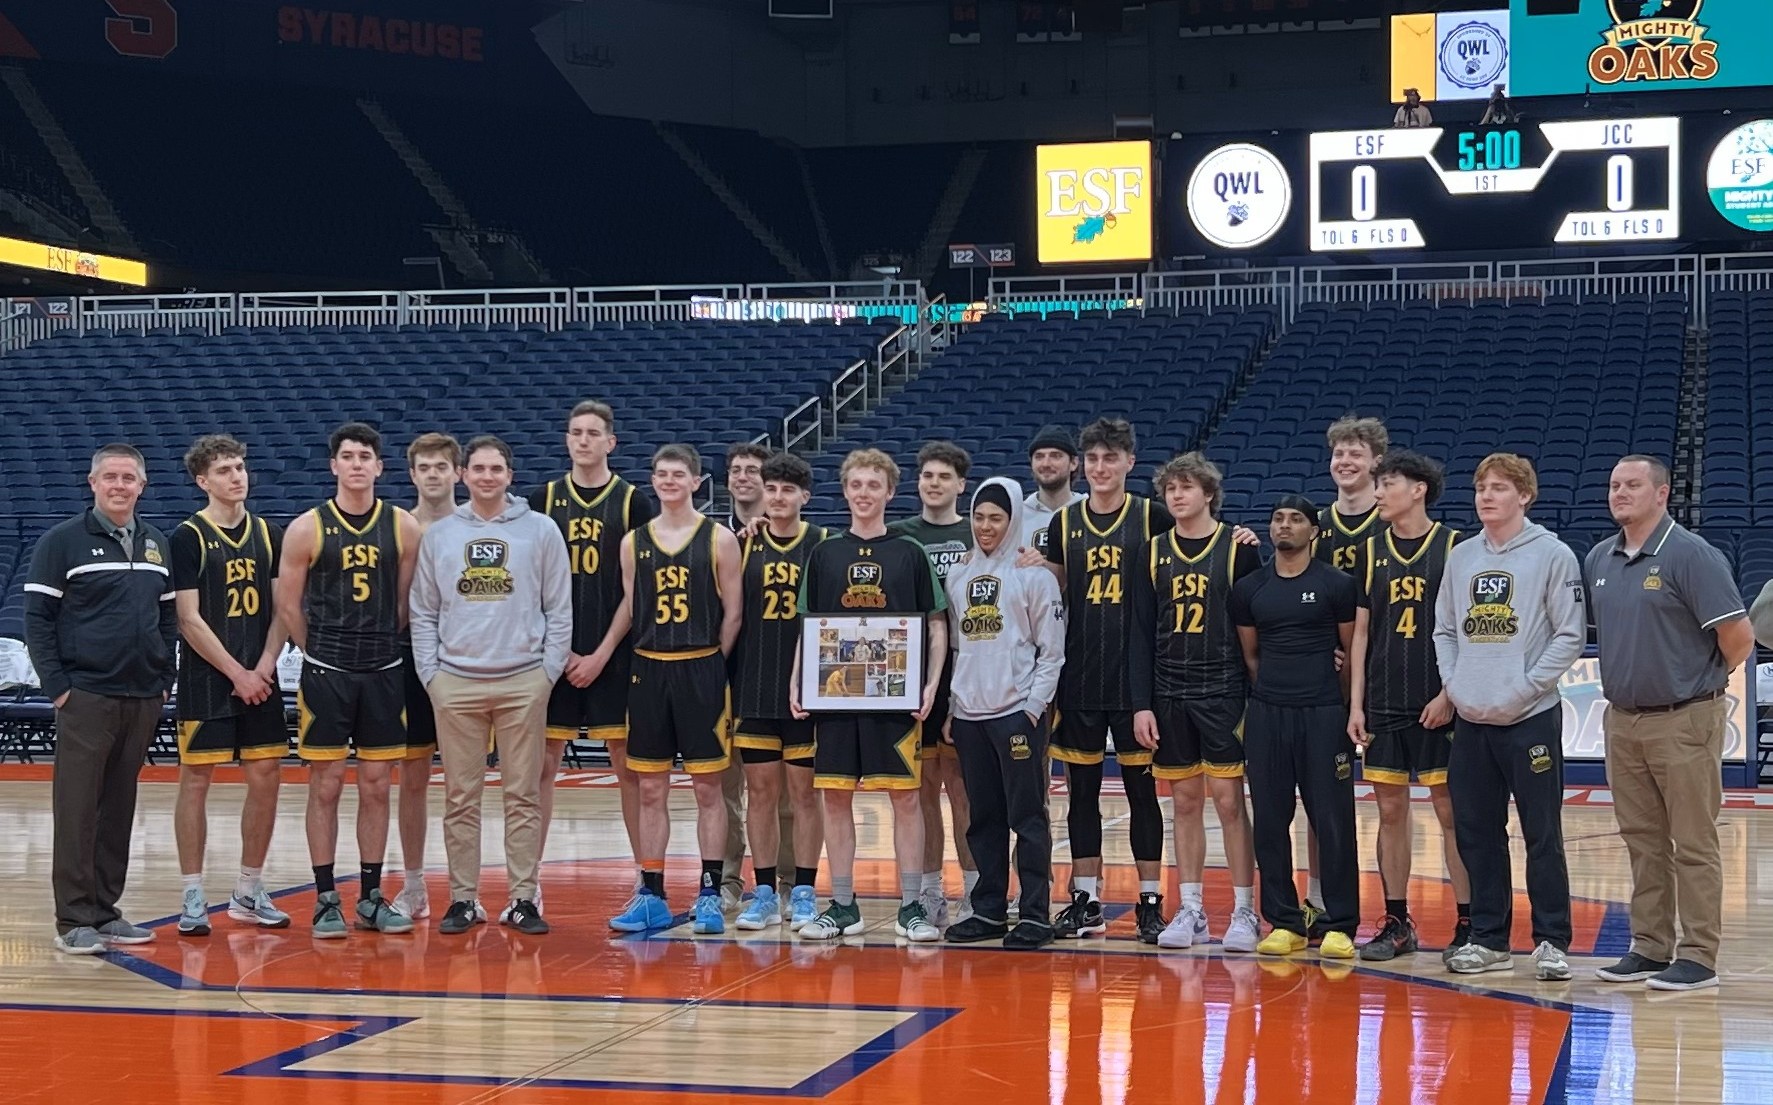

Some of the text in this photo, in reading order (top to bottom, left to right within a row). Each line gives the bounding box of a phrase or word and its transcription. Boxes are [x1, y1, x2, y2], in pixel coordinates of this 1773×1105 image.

[277, 4, 485, 63] SYRACUSE
[1619, 22, 1692, 39] MIGHTY
[1457, 39, 1490, 60] QWL
[1588, 40, 1719, 84] OAKS
[1355, 134, 1385, 155] ESF
[1601, 124, 1633, 145] JCC
[1458, 130, 1521, 171] 5:00
[1731, 158, 1766, 175] ESF
[1045, 166, 1143, 217] ESF
[1213, 171, 1264, 202] QWL
[1351, 165, 1377, 221] 0
[1475, 175, 1498, 192] 1ST
[1606, 153, 1634, 212] 0
[1322, 230, 1344, 245] TOL
[1351, 230, 1358, 243] 6
[1370, 228, 1394, 243] FLS
[1573, 221, 1596, 236] TOL
[1604, 220, 1611, 235] 6
[1624, 219, 1649, 234] FLS
[47, 247, 72, 272] ESF
[952, 250, 974, 264] 122
[989, 249, 1012, 262] 123
[14, 303, 31, 315] 121
[48, 302, 68, 314] 122
[567, 515, 604, 543] ESF
[341, 543, 380, 571] ESF
[471, 544, 503, 560] ESF
[570, 545, 600, 575] 10
[1085, 544, 1123, 573] ESF
[1332, 544, 1358, 571] ES
[226, 558, 256, 585] ESF
[655, 565, 690, 593] ESF
[762, 560, 801, 587] ESF
[853, 566, 878, 578] ESF
[352, 572, 371, 603] 5
[458, 577, 514, 596] OAKS
[972, 581, 998, 598] ESF
[1085, 573, 1124, 605] 44
[1171, 572, 1210, 601] ESF
[1389, 575, 1427, 605] ESF
[1476, 577, 1508, 594] ESF
[1573, 588, 1583, 603] 12
[227, 586, 260, 618] 20
[655, 594, 690, 625] 55
[762, 590, 798, 621] 23
[961, 616, 1004, 634] OAKS
[1173, 602, 1205, 634] 12
[1395, 606, 1417, 639] 4
[1463, 616, 1519, 636] OAKS
